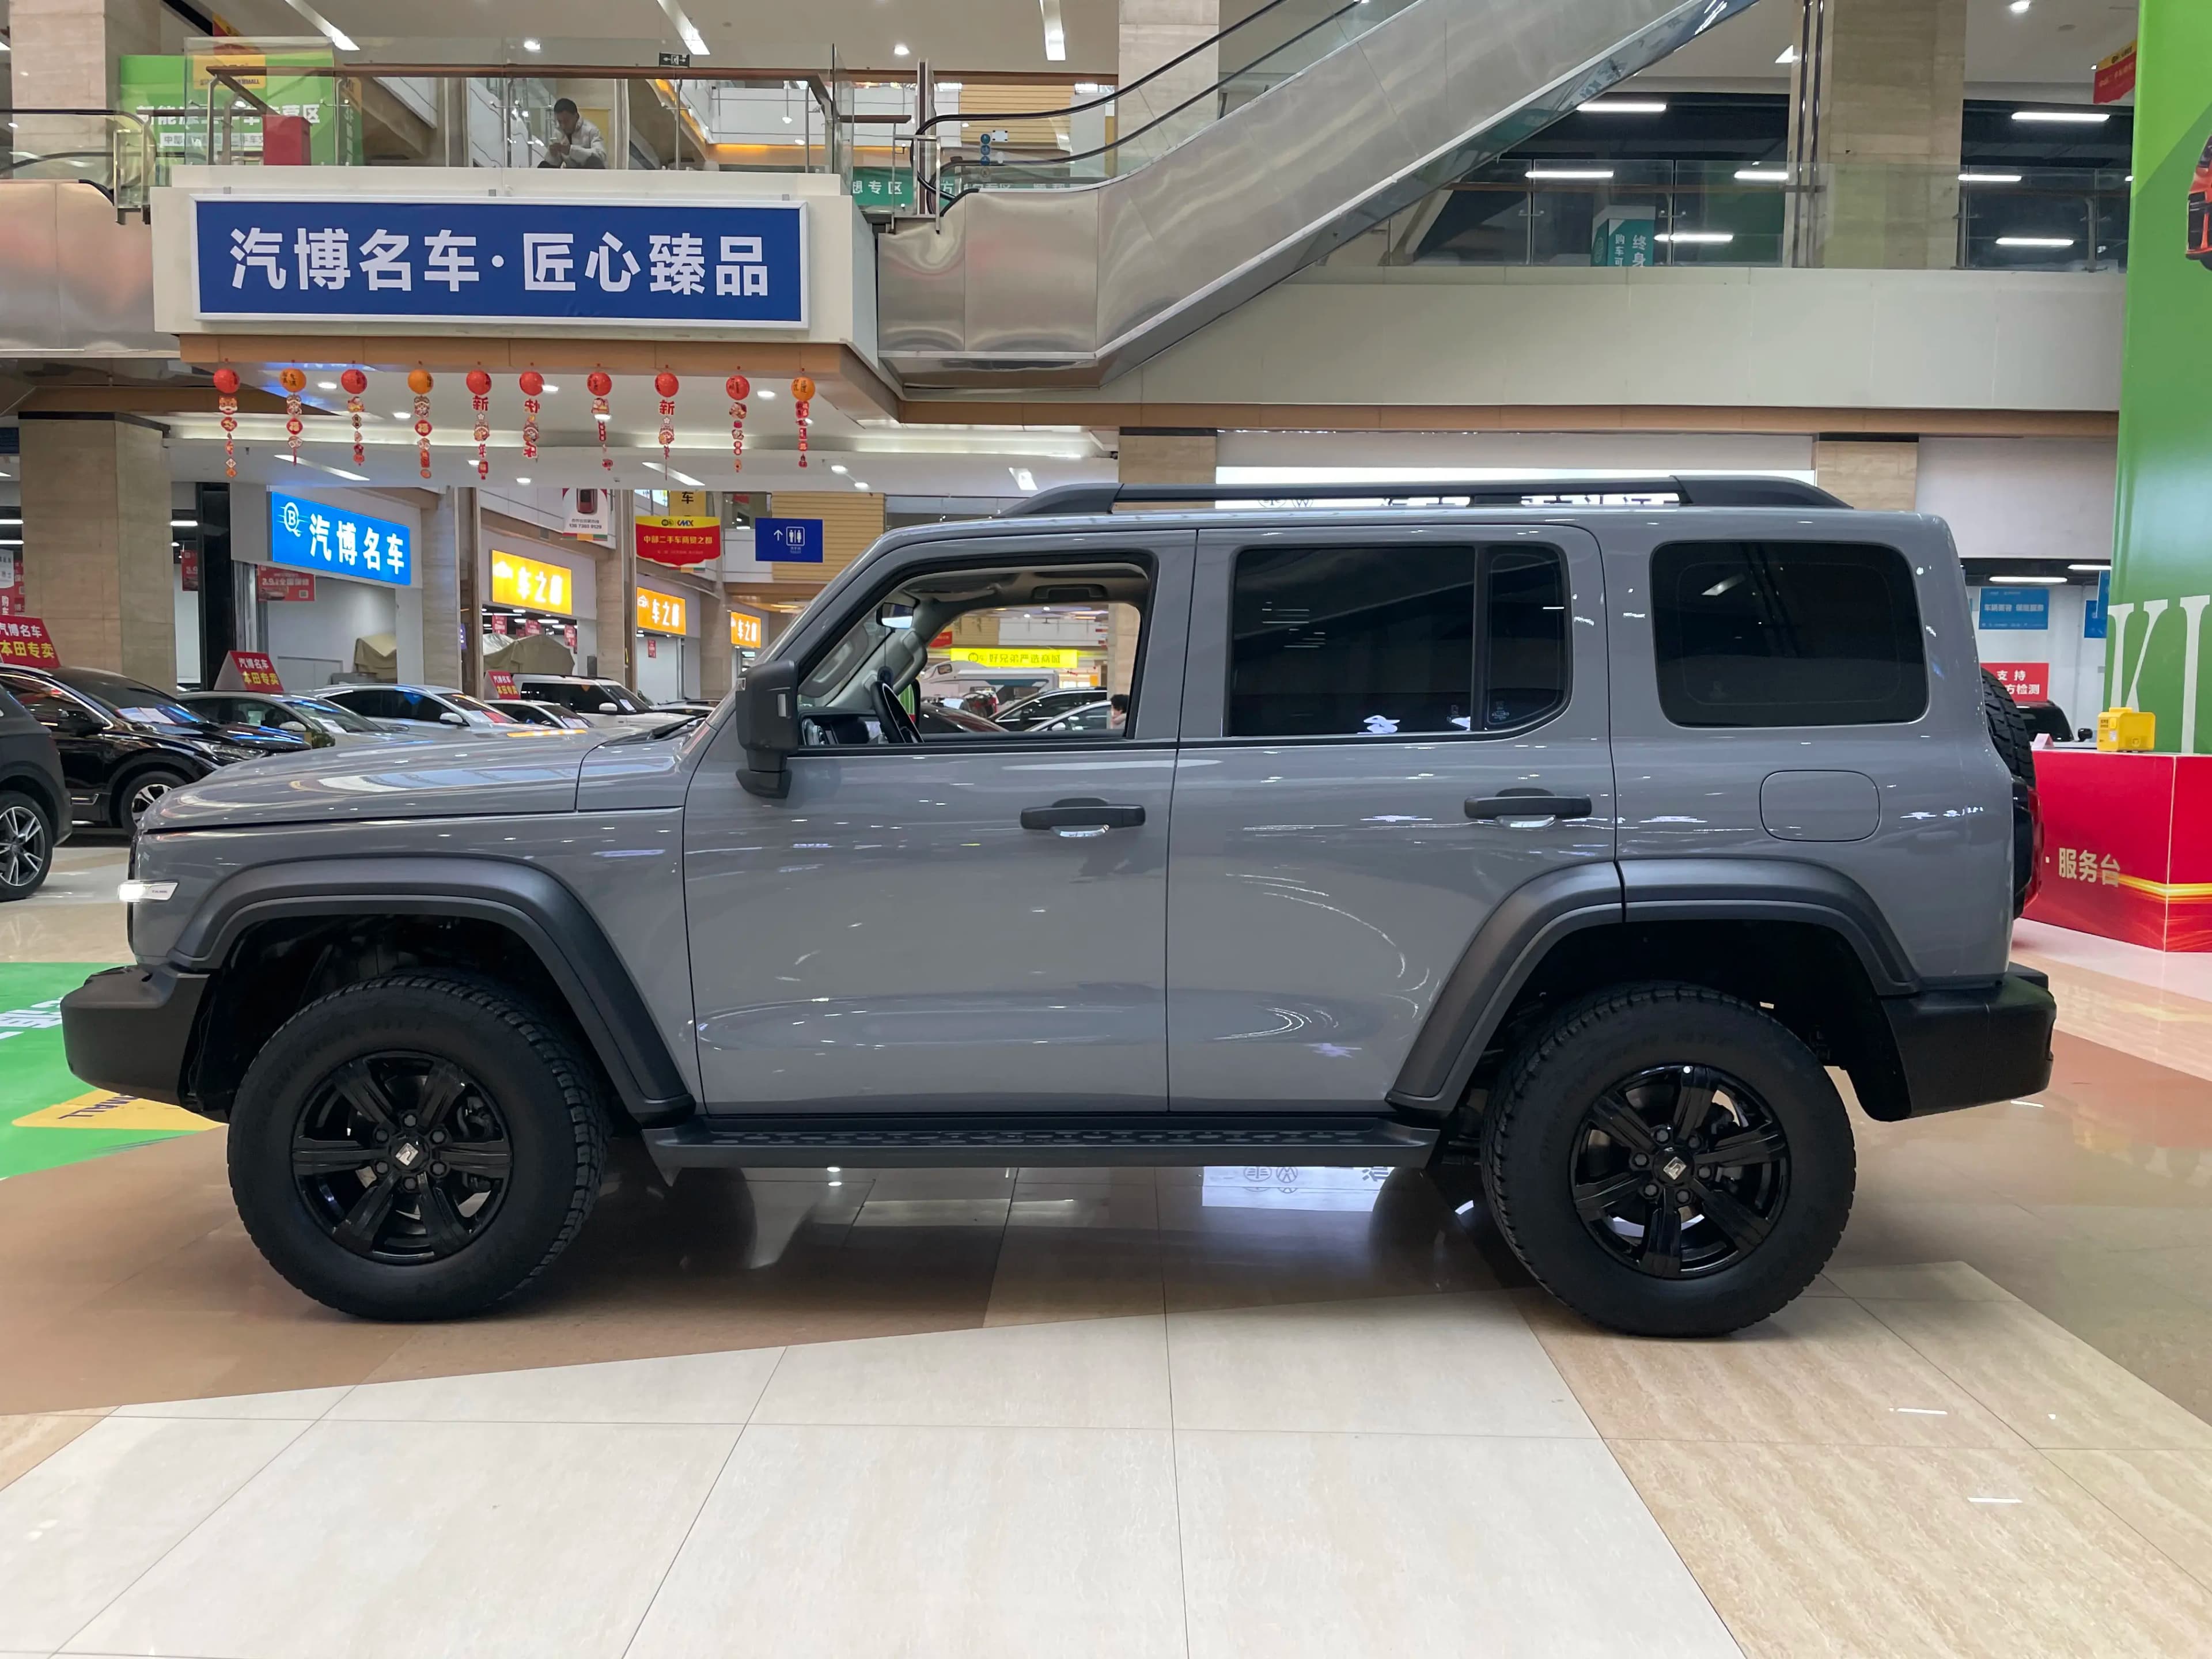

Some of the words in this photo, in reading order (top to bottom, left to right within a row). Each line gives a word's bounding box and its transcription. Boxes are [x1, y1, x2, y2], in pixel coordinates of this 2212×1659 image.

[230, 227, 768, 297] 汽博名车·匠心臻品
[309, 513, 404, 575] 汽博名车
[0, 640, 55, 658] 本田专卖
[243, 671, 279, 685] 本田专卖
[1997, 670, 2026, 681] 支持
[2059, 847, 2120, 888] 服务台
